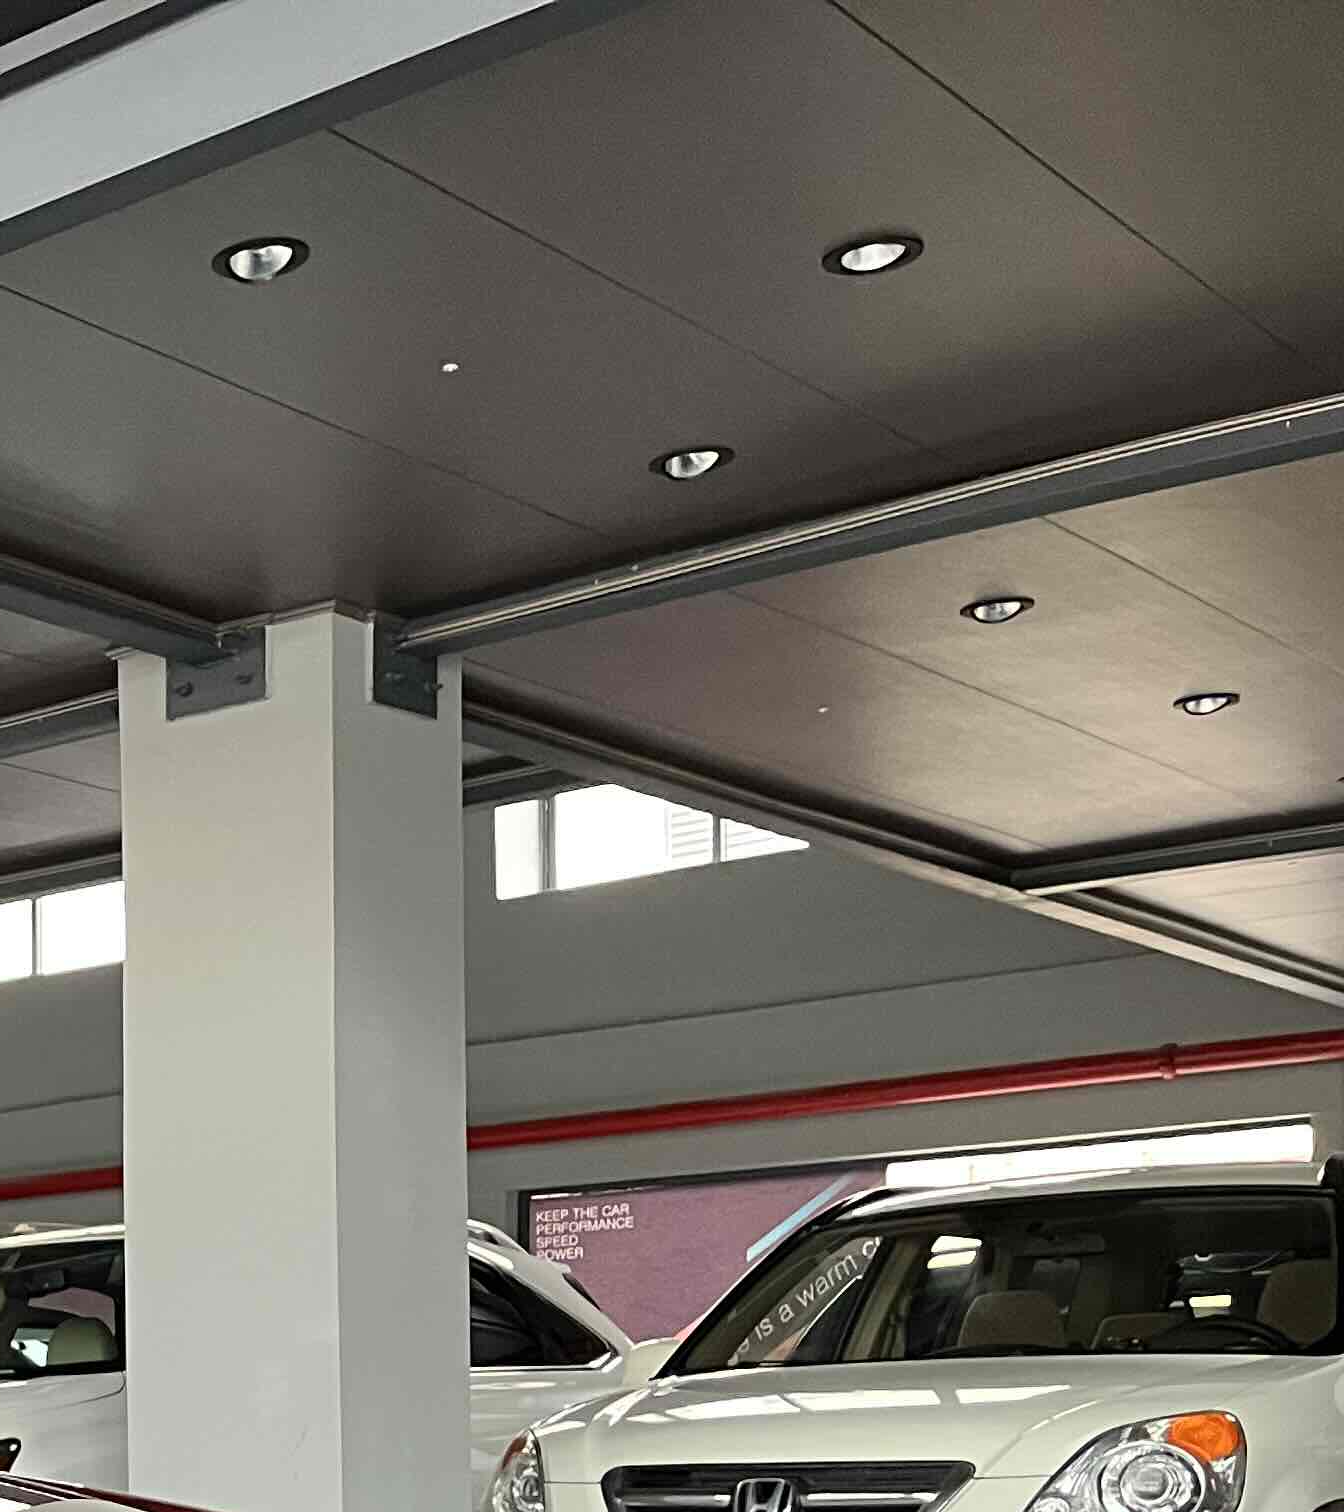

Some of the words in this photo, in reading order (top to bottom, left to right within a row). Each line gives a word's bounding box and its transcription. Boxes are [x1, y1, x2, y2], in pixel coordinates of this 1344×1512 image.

[535, 1208, 569, 1222] KEEP
[573, 1206, 598, 1220] THE
[601, 1203, 630, 1217] CAR
[535, 1216, 634, 1236] PERFORMANCE
[536, 1234, 579, 1249] SPEED
[536, 1246, 584, 1260] POWER
[778, 1302, 795, 1323] a
[795, 1254, 858, 1308] warm
